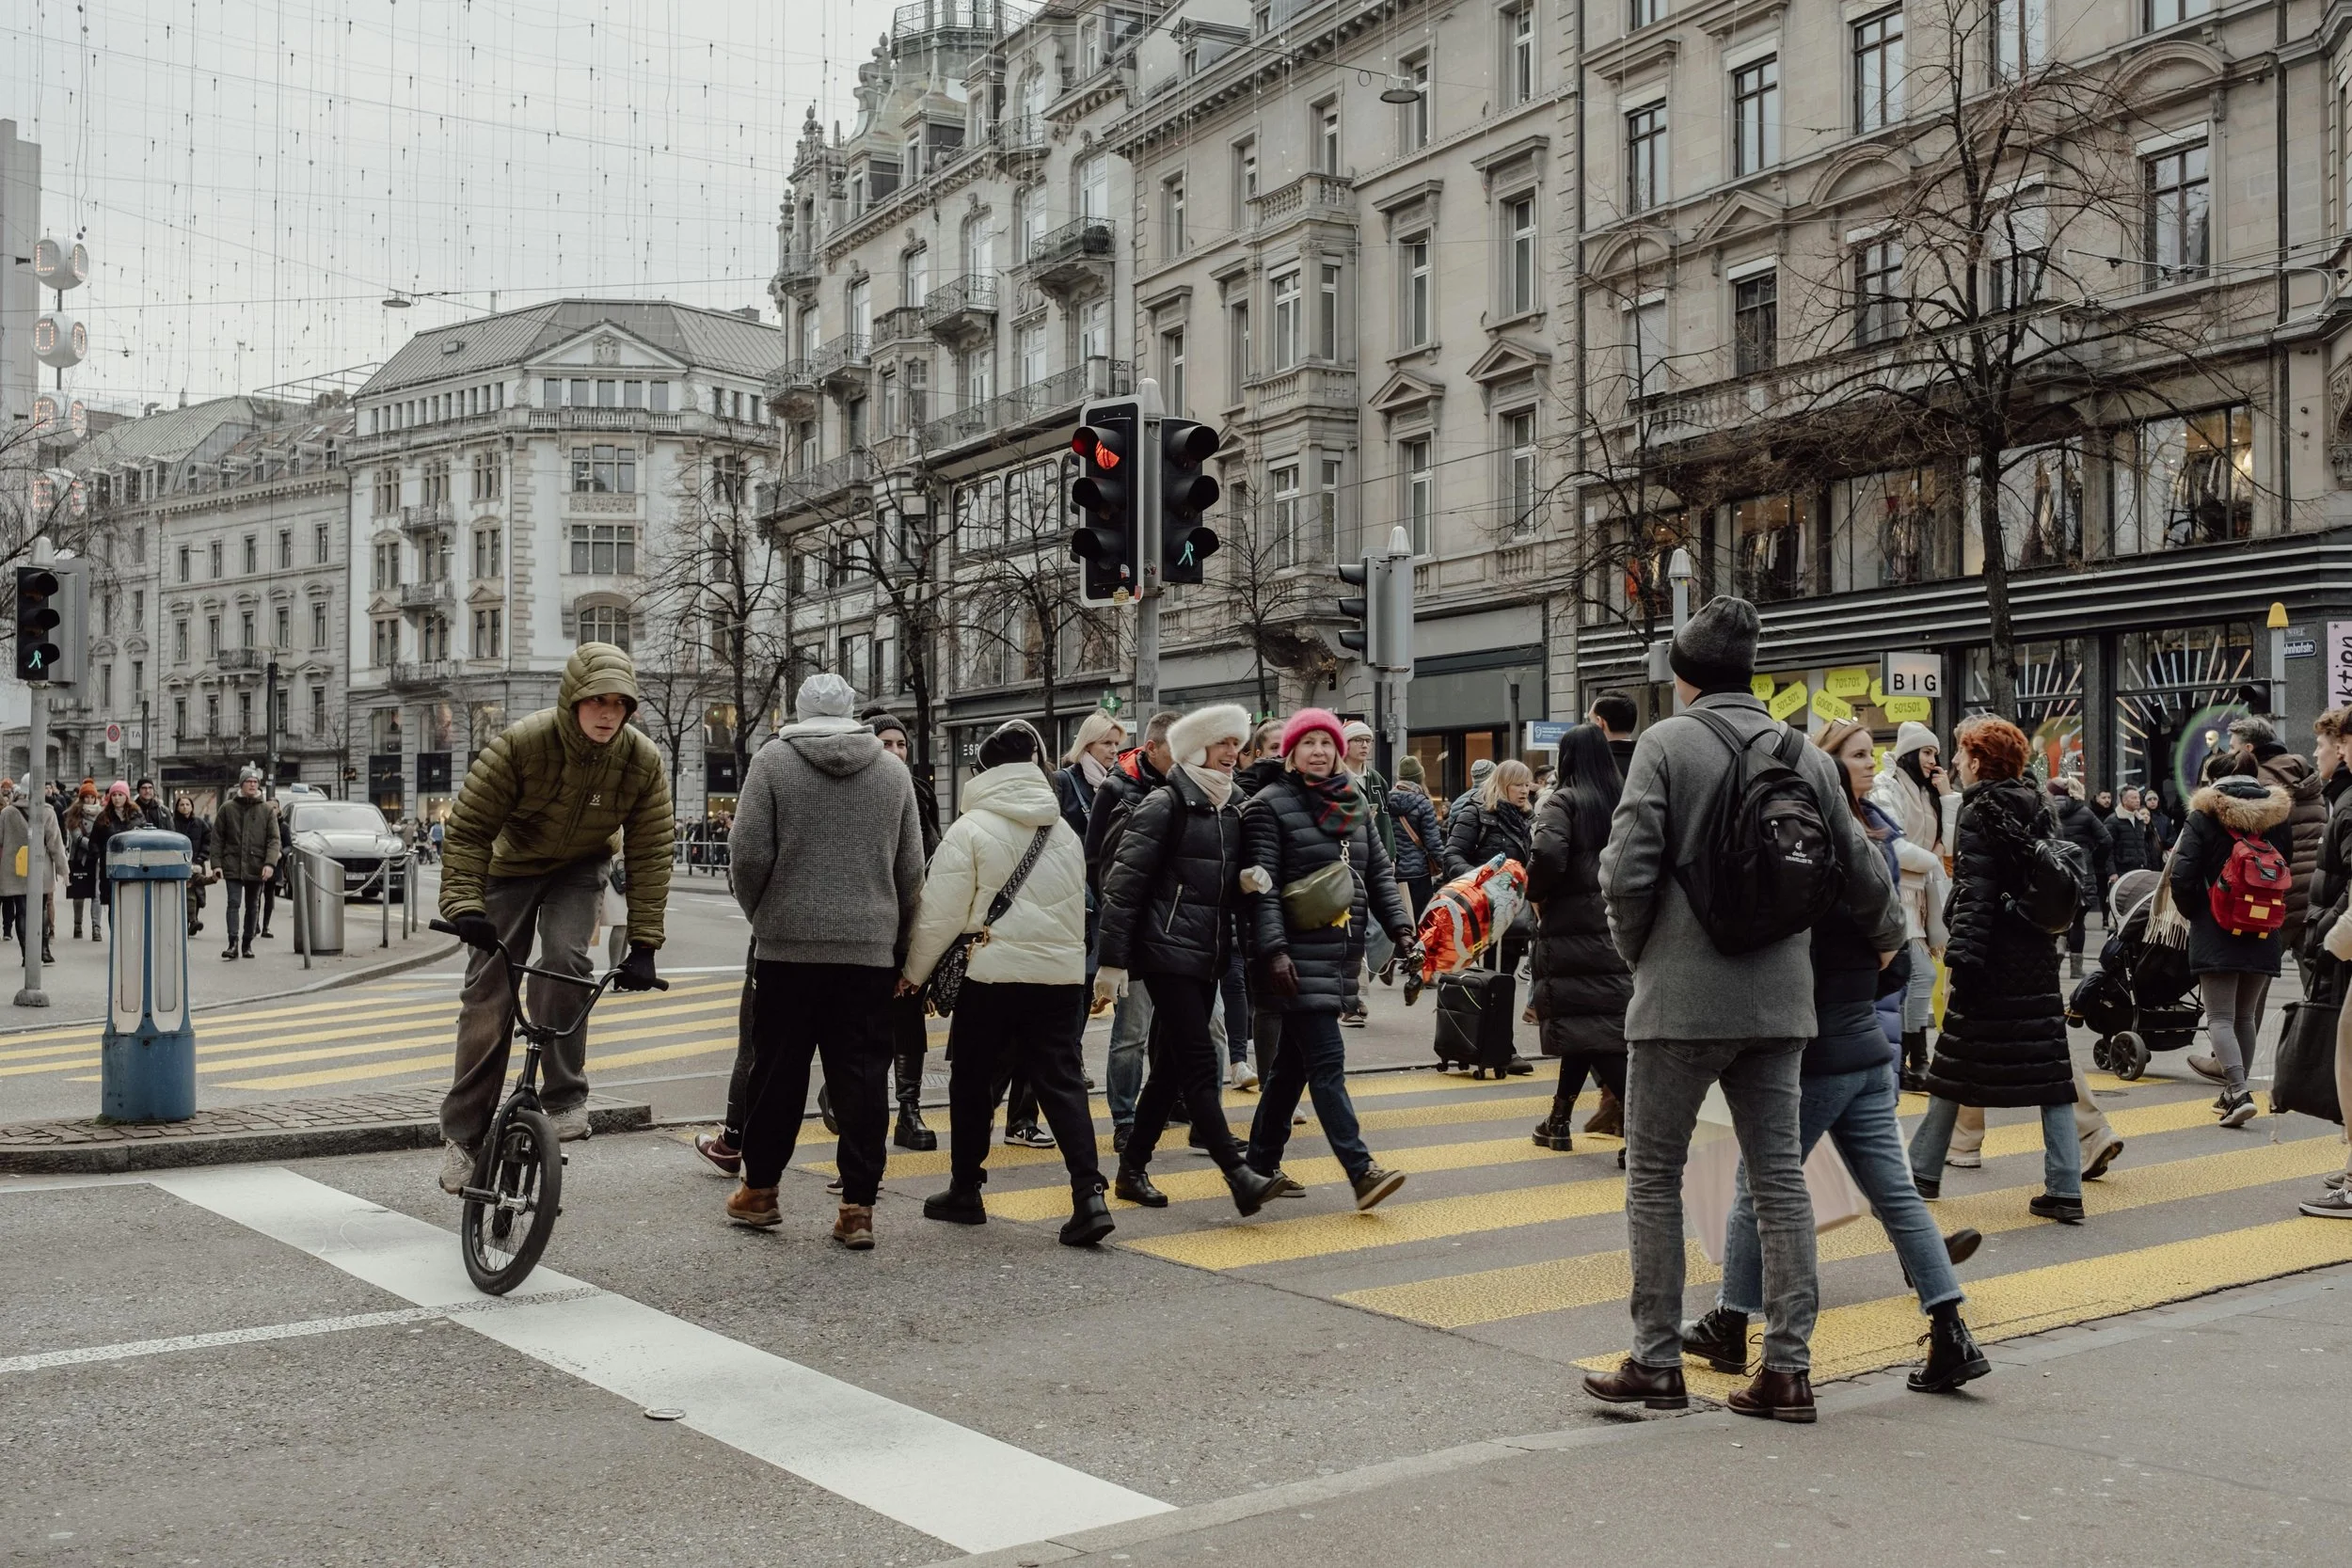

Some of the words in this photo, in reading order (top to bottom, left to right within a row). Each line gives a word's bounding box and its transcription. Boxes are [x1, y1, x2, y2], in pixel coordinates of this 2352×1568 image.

[1757, 682, 1771, 693] BUY
[1893, 673, 1936, 692] BIG
[1816, 697, 1833, 714] GOOD
[1834, 705, 1848, 719] BUY
